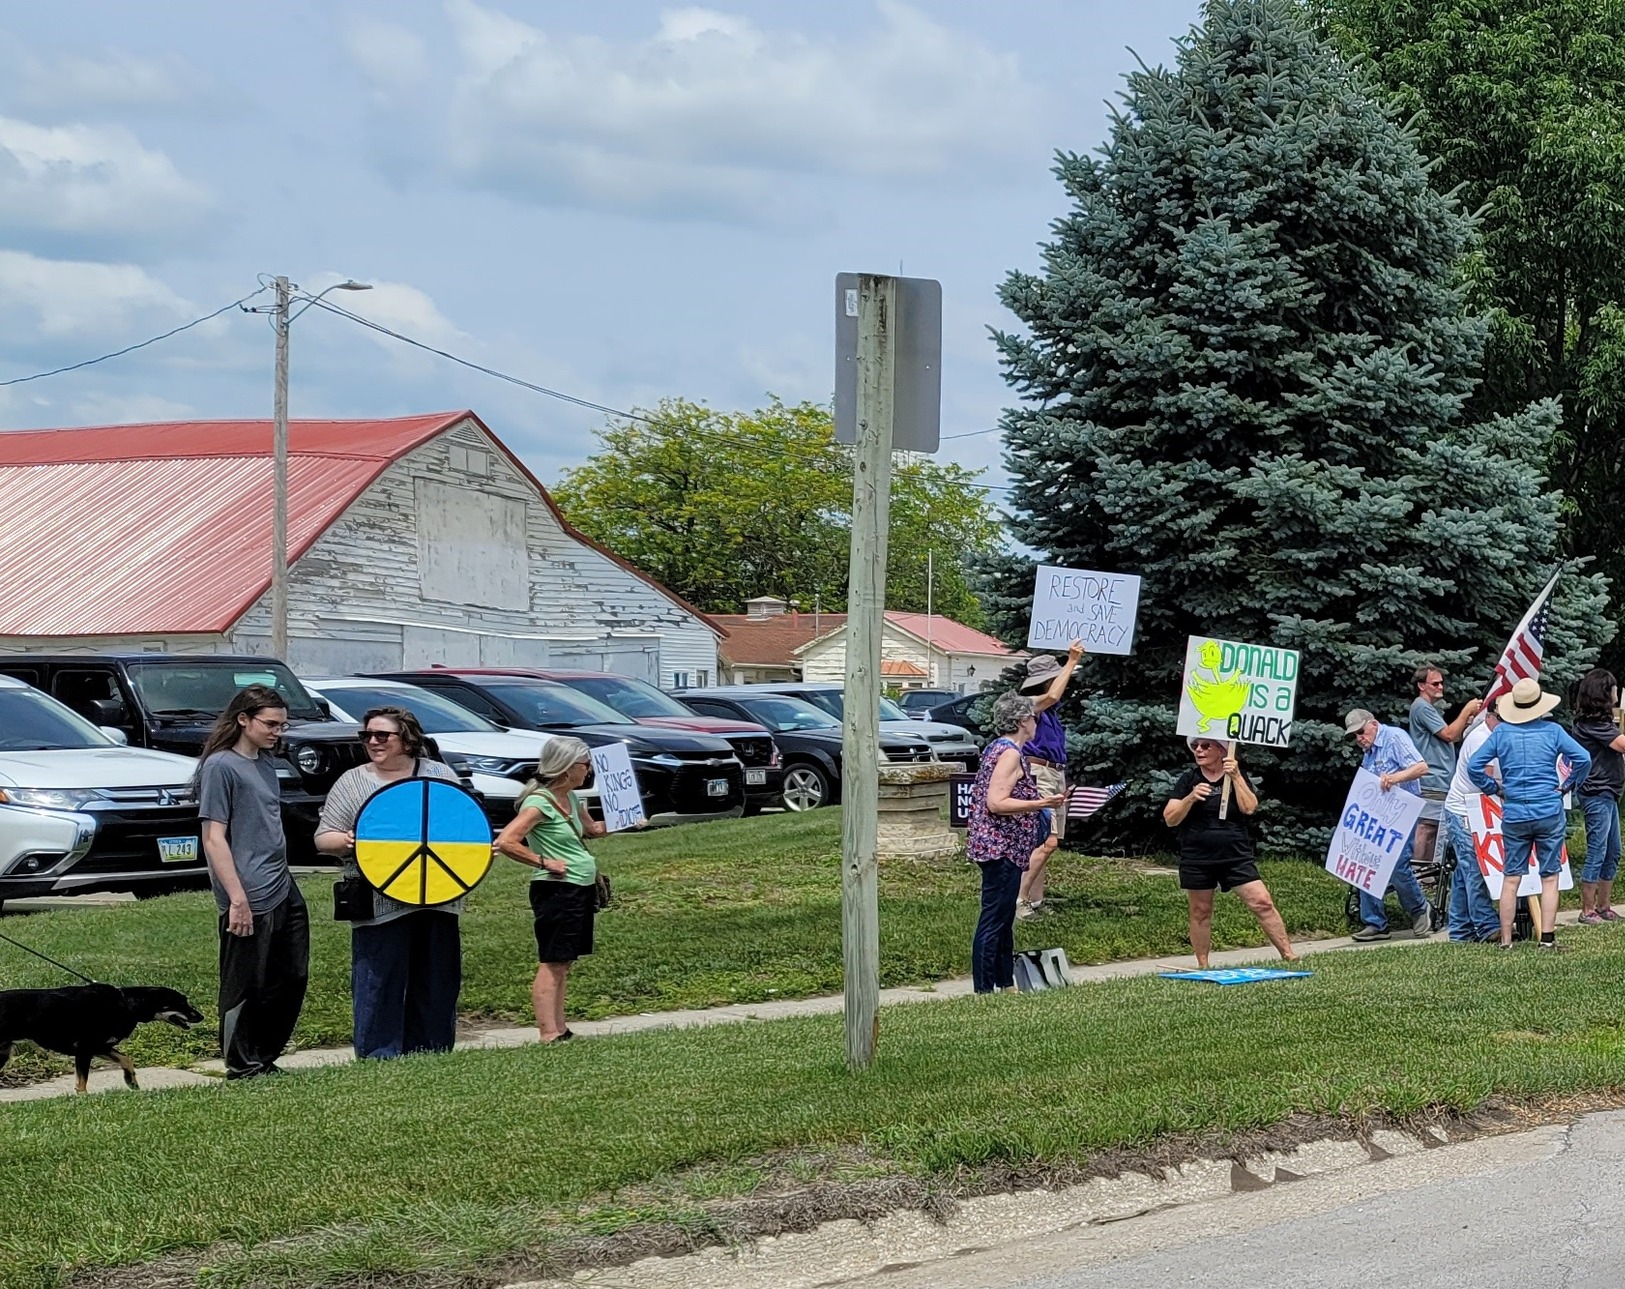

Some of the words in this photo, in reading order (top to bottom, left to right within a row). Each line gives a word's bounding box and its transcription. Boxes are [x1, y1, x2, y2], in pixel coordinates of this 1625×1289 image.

[1049, 575, 1125, 605] RESTORE
[1067, 603, 1085, 614] and
[1087, 604, 1122, 624] SAVE
[1034, 619, 1129, 647] DEMOCRACY
[1220, 642, 1298, 682] DONALD
[1248, 683, 1269, 709] IS
[1275, 687, 1292, 711] a
[1226, 712, 1292, 745] QUACK
[594, 753, 609, 773] NO
[603, 769, 632, 793] KINGS
[603, 793, 618, 813] NO
[1358, 781, 1407, 827] Only
[1342, 803, 1404, 853] GREAT
[176, 843, 192, 857] 243
[1335, 855, 1376, 890] HATE
